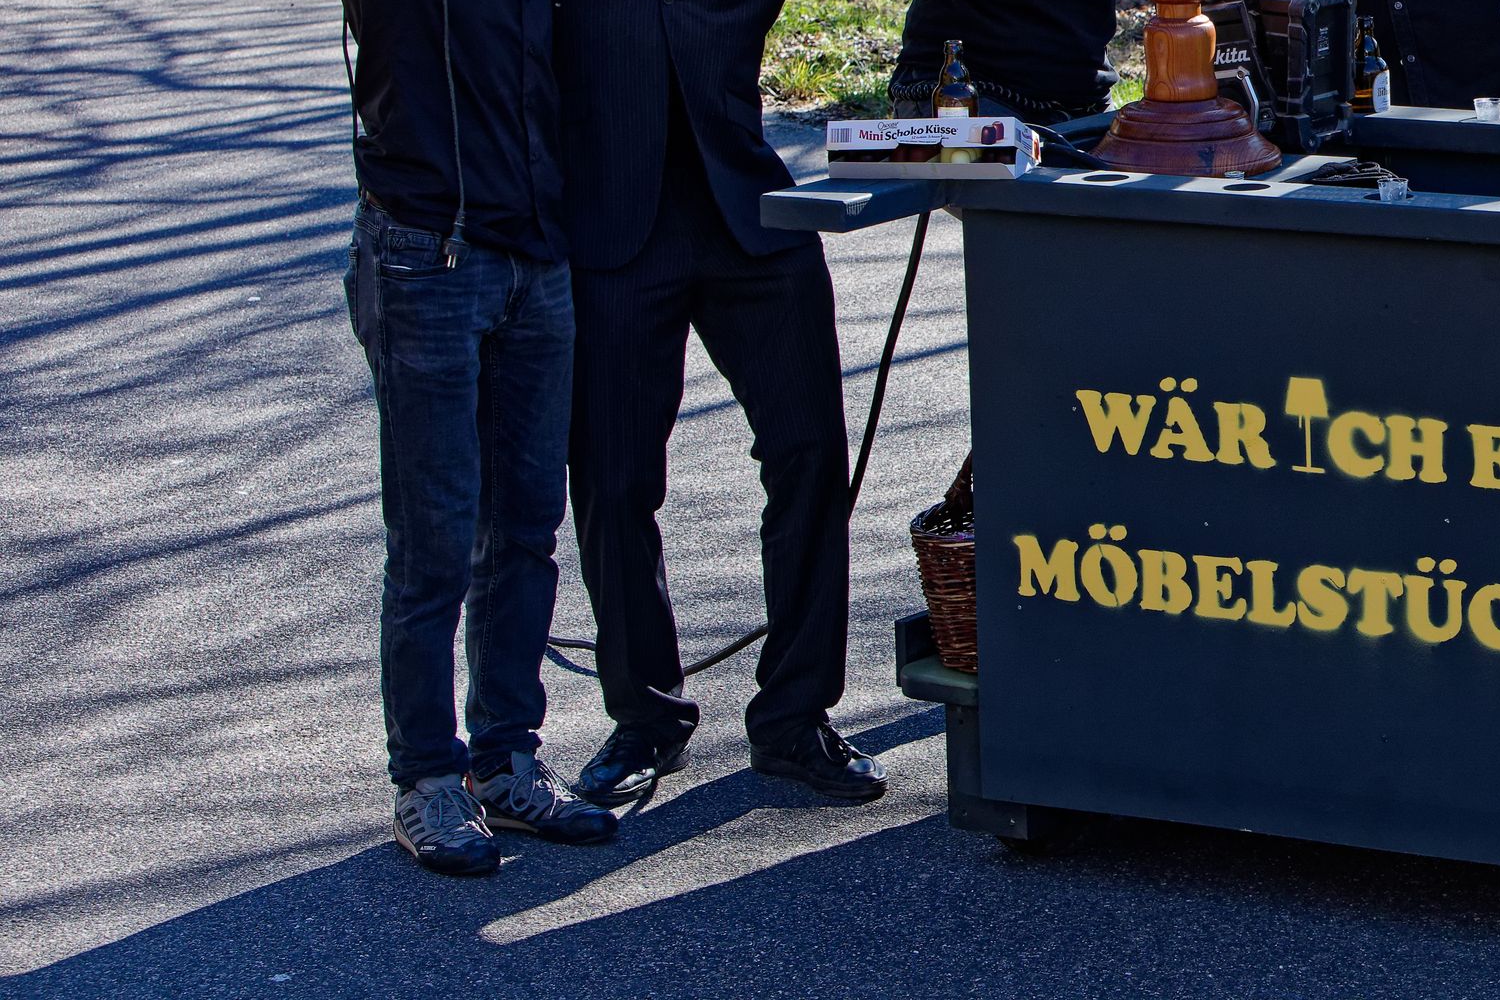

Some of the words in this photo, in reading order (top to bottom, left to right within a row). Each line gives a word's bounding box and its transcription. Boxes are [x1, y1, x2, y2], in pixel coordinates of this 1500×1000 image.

[1214, 47, 1250, 65] kita
[858, 128, 884, 141] Mini
[885, 125, 924, 140] Schoko
[925, 124, 957, 136] Küsse
[1076, 377, 1275, 468] WÄR
